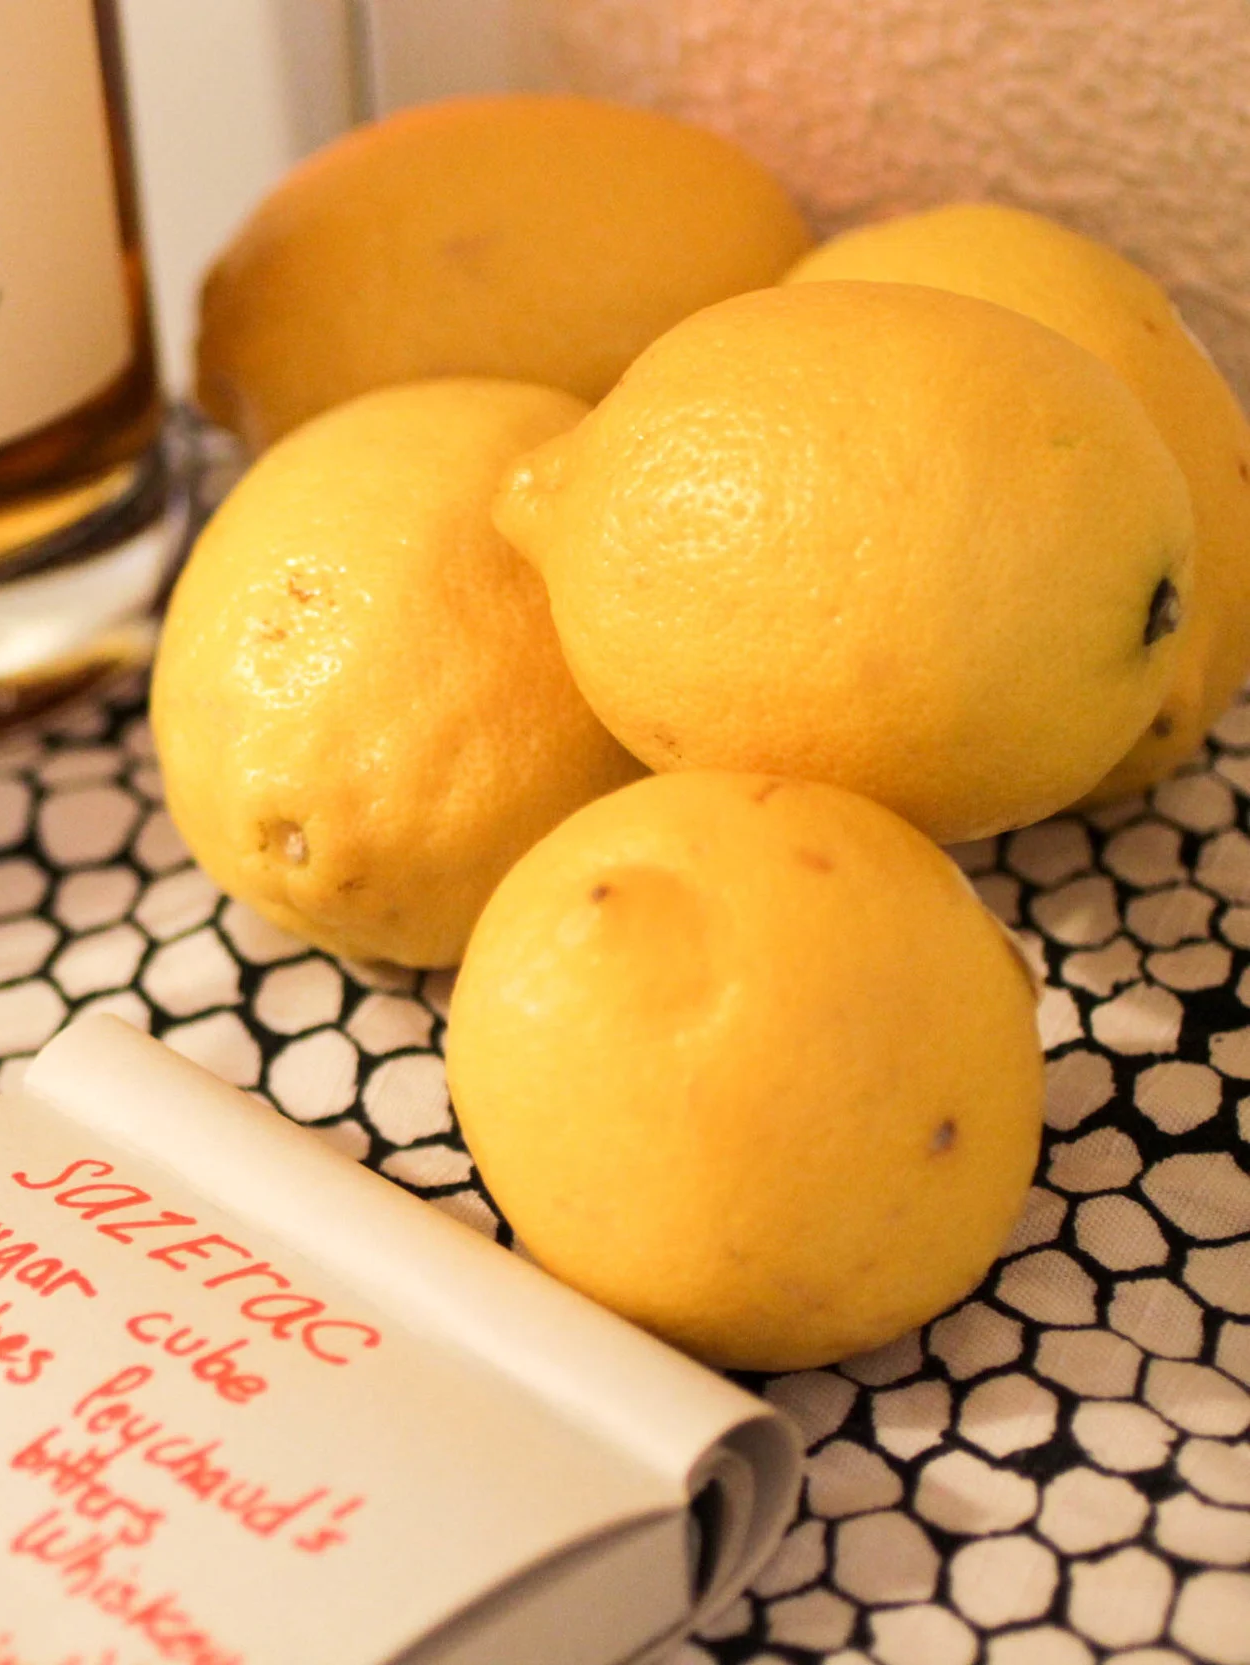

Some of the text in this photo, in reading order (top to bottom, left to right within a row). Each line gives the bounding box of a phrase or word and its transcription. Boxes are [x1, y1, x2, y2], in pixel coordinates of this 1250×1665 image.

[125, 1311, 269, 1405] cube
[9, 1426, 168, 1547] bitters
[72, 1364, 367, 1556] Peychaud's
